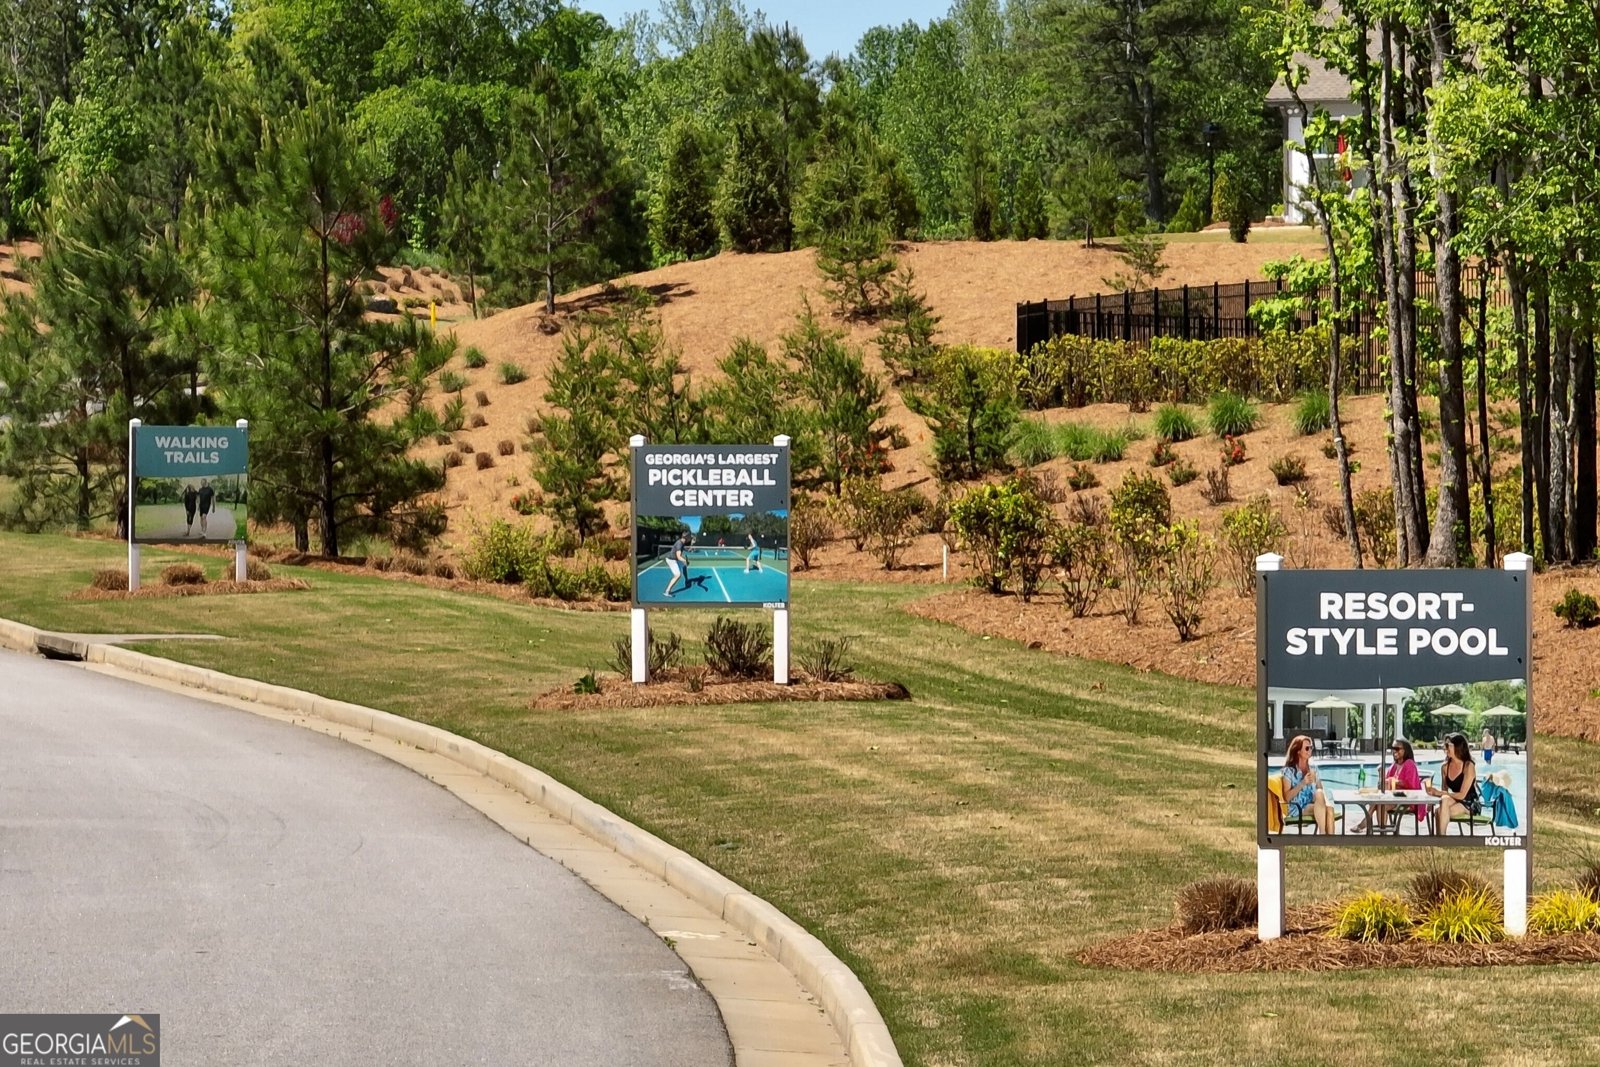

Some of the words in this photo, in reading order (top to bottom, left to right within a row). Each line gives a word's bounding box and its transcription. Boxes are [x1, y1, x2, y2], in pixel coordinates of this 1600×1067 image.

[155, 436, 229, 448] WALKING
[164, 451, 219, 463] TRAILS
[645, 453, 715, 465] GEORGIA'S
[718, 453, 779, 465] LARGEST
[648, 469, 776, 486] PICKLEBALL
[669, 489, 754, 507] CENTER
[1319, 592, 1475, 620] RESORT-
[1285, 628, 1399, 656] STYLE
[1408, 628, 1509, 656] POOL
[1484, 836, 1521, 846] KOLTER
